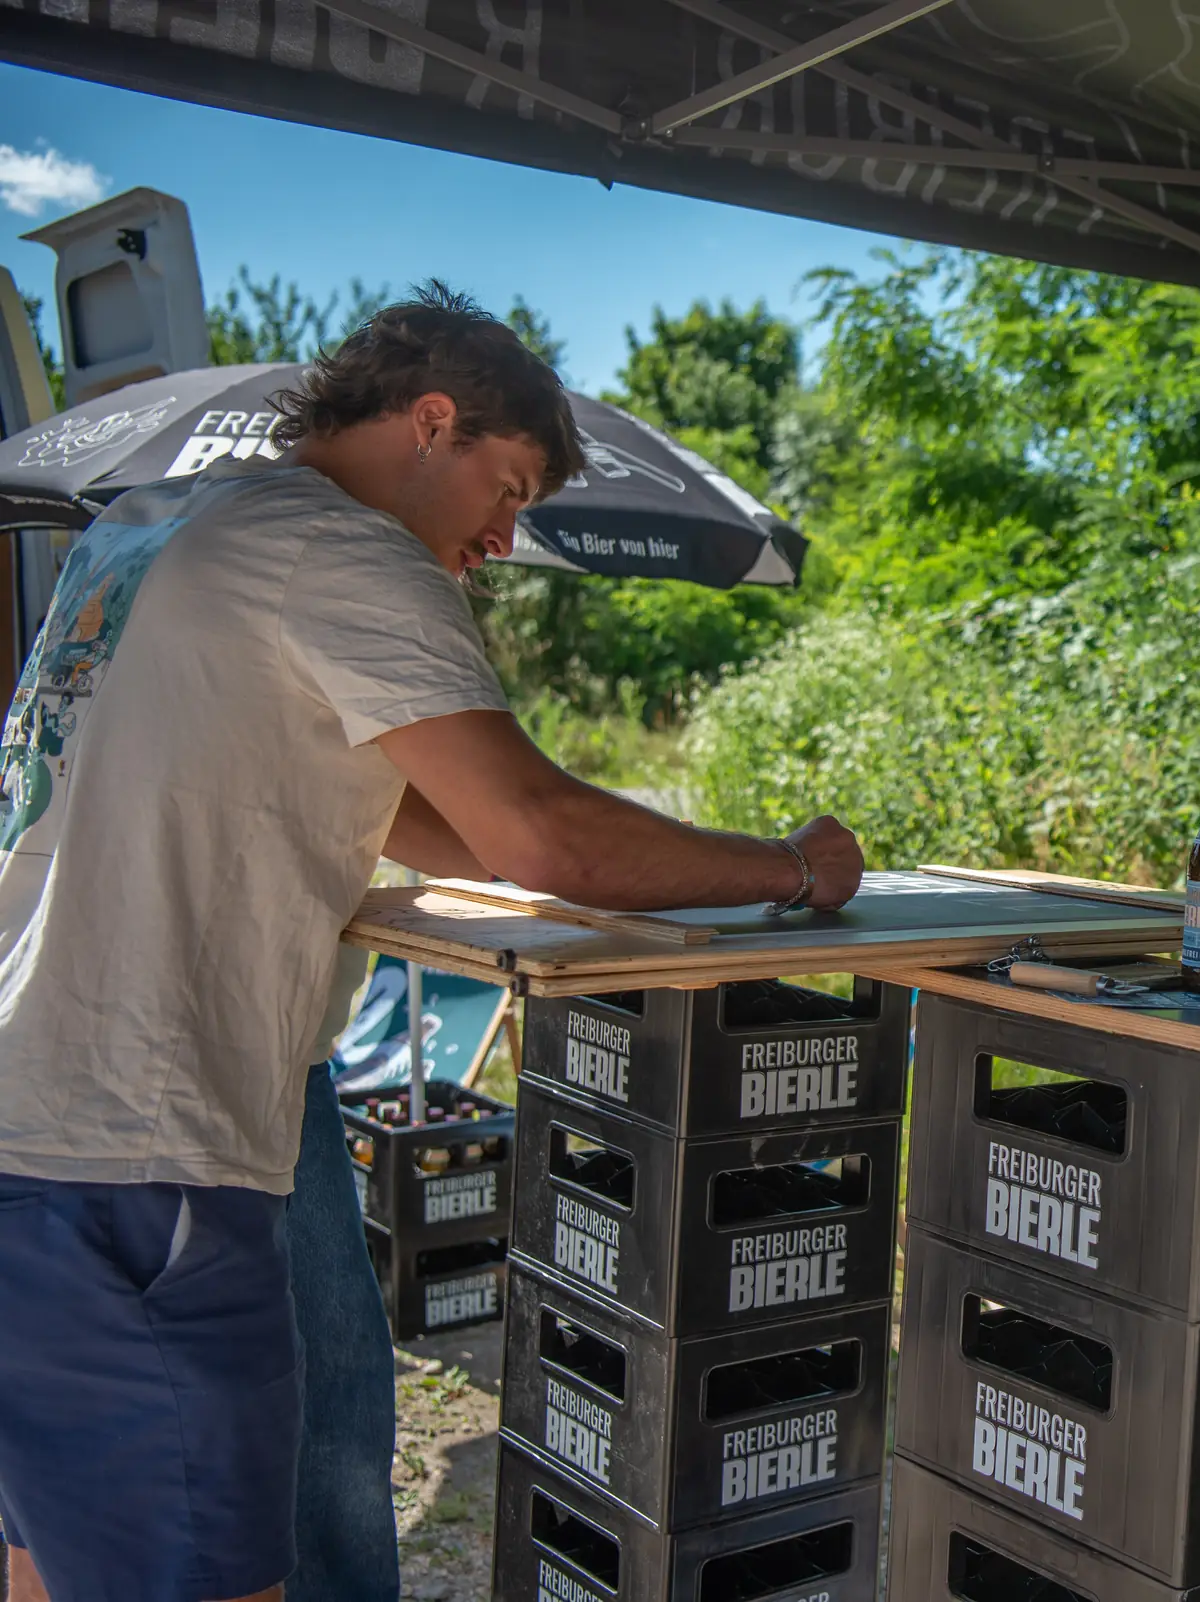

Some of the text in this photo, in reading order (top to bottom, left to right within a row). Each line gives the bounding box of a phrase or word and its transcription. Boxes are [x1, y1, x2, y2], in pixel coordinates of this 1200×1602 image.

[581, 532, 616, 556] Bier
[619, 538, 645, 558] von
[648, 536, 680, 560] hier
[567, 1010, 631, 1056] FREIBURGER
[742, 1036, 858, 1070] FREIBURGER
[565, 1037, 630, 1102] BIERLE
[740, 1062, 859, 1118] BIERLE
[989, 1141, 1101, 1207] FREIBURGER
[425, 1187, 497, 1224] BIERLE
[556, 1194, 620, 1249] FREIBURGER
[985, 1177, 1100, 1270] BIERLE
[554, 1220, 619, 1295] BIERLE
[731, 1224, 848, 1265] FREIBURGER
[425, 1288, 497, 1328] BIERLE
[728, 1249, 846, 1313] BIERLE
[546, 1377, 612, 1438] FREIBURGER
[723, 1409, 838, 1459] FREIBURGER
[976, 1381, 1087, 1460] FREIBURGER
[545, 1411, 612, 1486] BIERLE
[721, 1436, 838, 1507] BIERLE
[973, 1417, 1086, 1521] BIERLE
